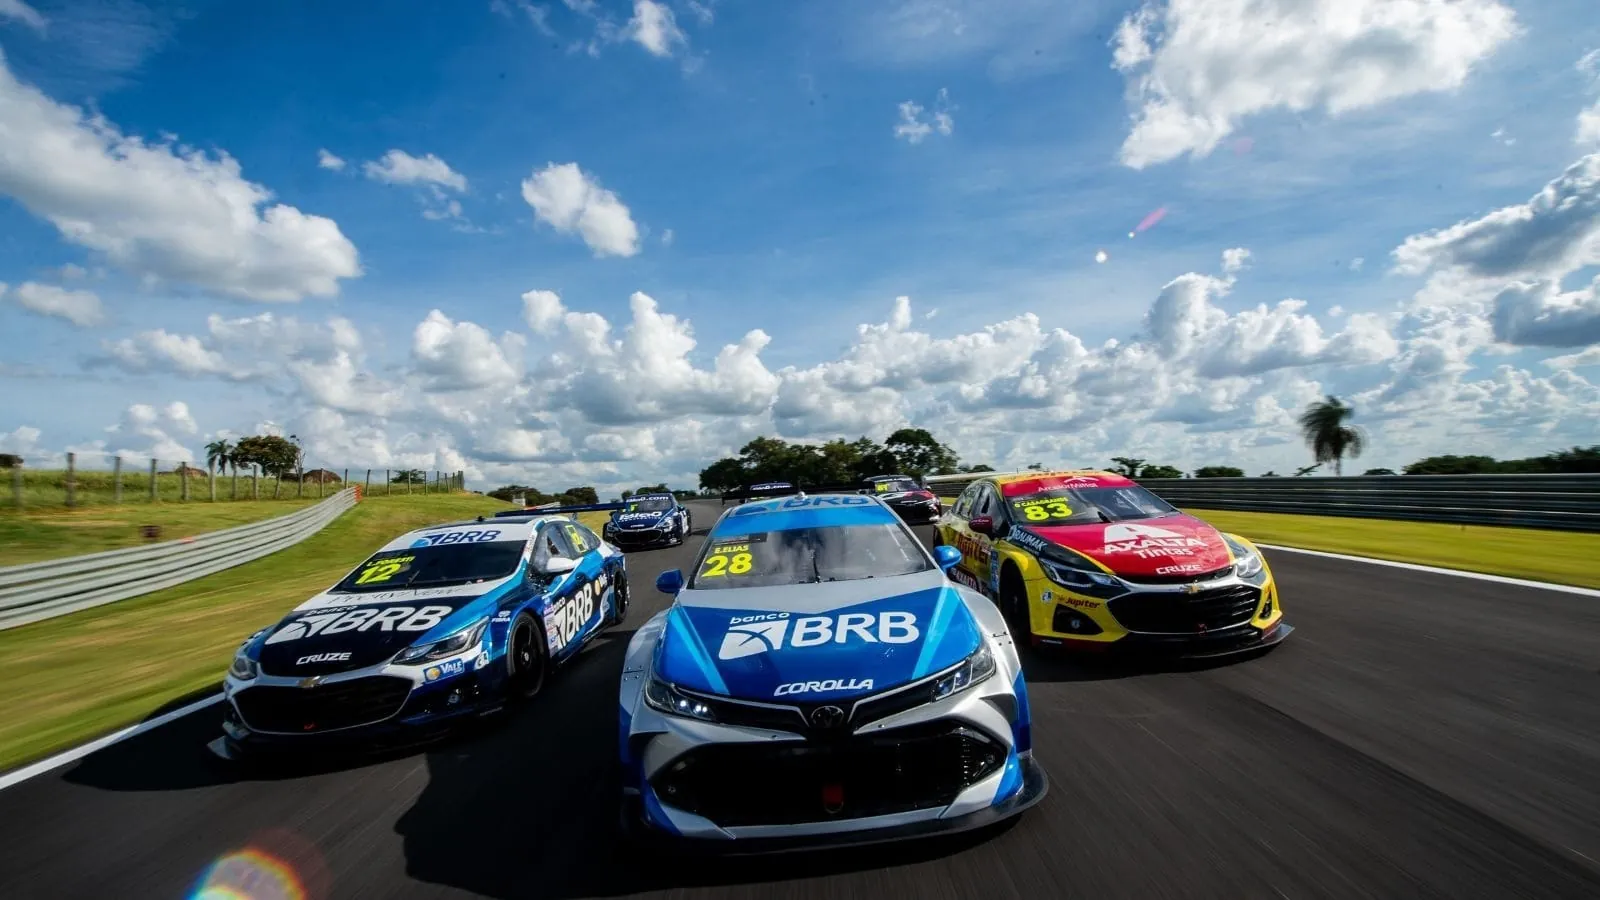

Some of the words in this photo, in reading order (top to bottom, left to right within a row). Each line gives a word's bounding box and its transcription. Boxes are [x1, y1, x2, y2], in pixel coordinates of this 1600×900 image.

[1024, 502, 1073, 521] 83
[441, 530, 501, 543] BRB
[714, 544, 749, 554] E.ELIAS
[1104, 538, 1208, 555] AXALTA
[1133, 547, 1194, 559] Tintas
[701, 552, 753, 578] 28
[1155, 564, 1202, 574] CRUZE
[355, 563, 401, 585] 12
[1065, 597, 1101, 609] Jupiter
[319, 605, 453, 636] BRB
[566, 582, 594, 643] BRB
[729, 612, 790, 625] banco
[790, 611, 921, 648] BRB
[295, 651, 353, 666] CRUZE
[773, 678, 875, 697] COROLLA
